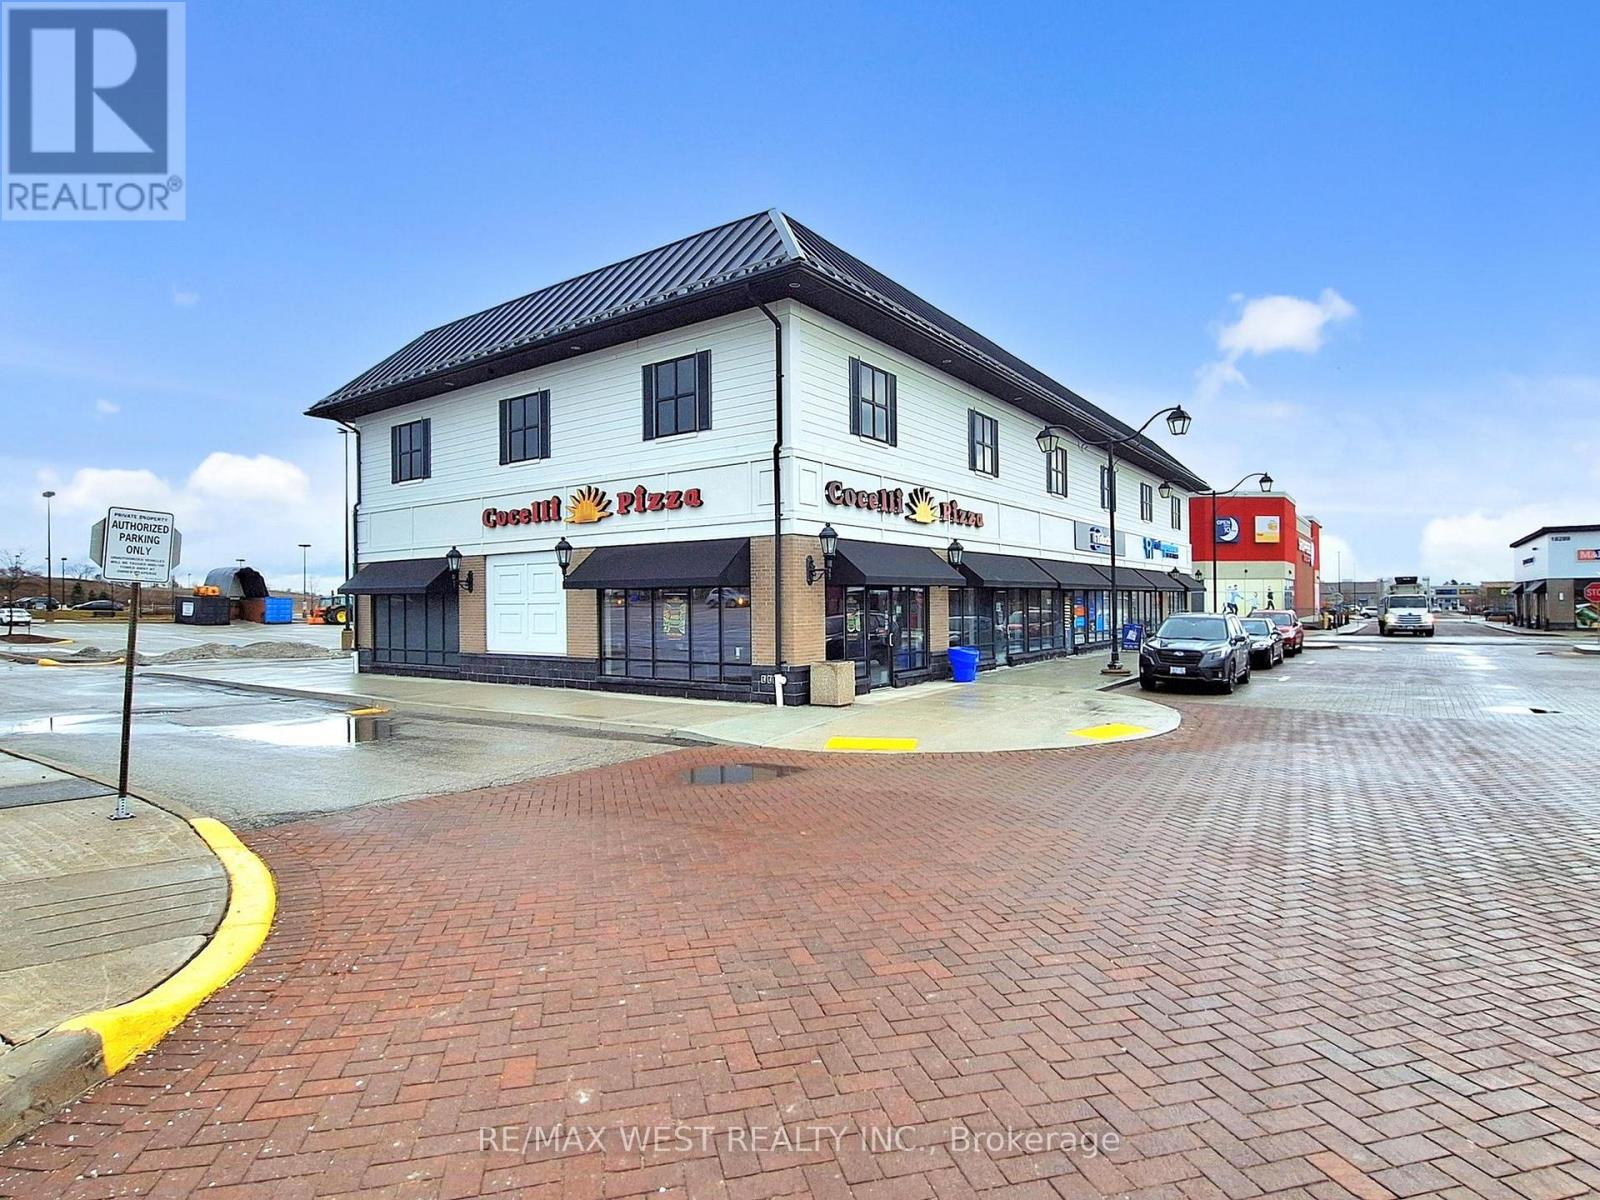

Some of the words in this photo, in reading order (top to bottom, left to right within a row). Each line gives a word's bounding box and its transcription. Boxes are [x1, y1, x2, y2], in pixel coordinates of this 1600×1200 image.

[482, 495, 562, 528] Cocelli
[617, 484, 704, 515] Pizza
[825, 480, 904, 514] Cocelli
[939, 499, 984, 528] Pizza
[111, 520, 169, 534] AUTHORIZED
[119, 532, 160, 545] PARKING
[126, 545, 152, 555] ONLY
[1586, 588, 1600, 597] STO
